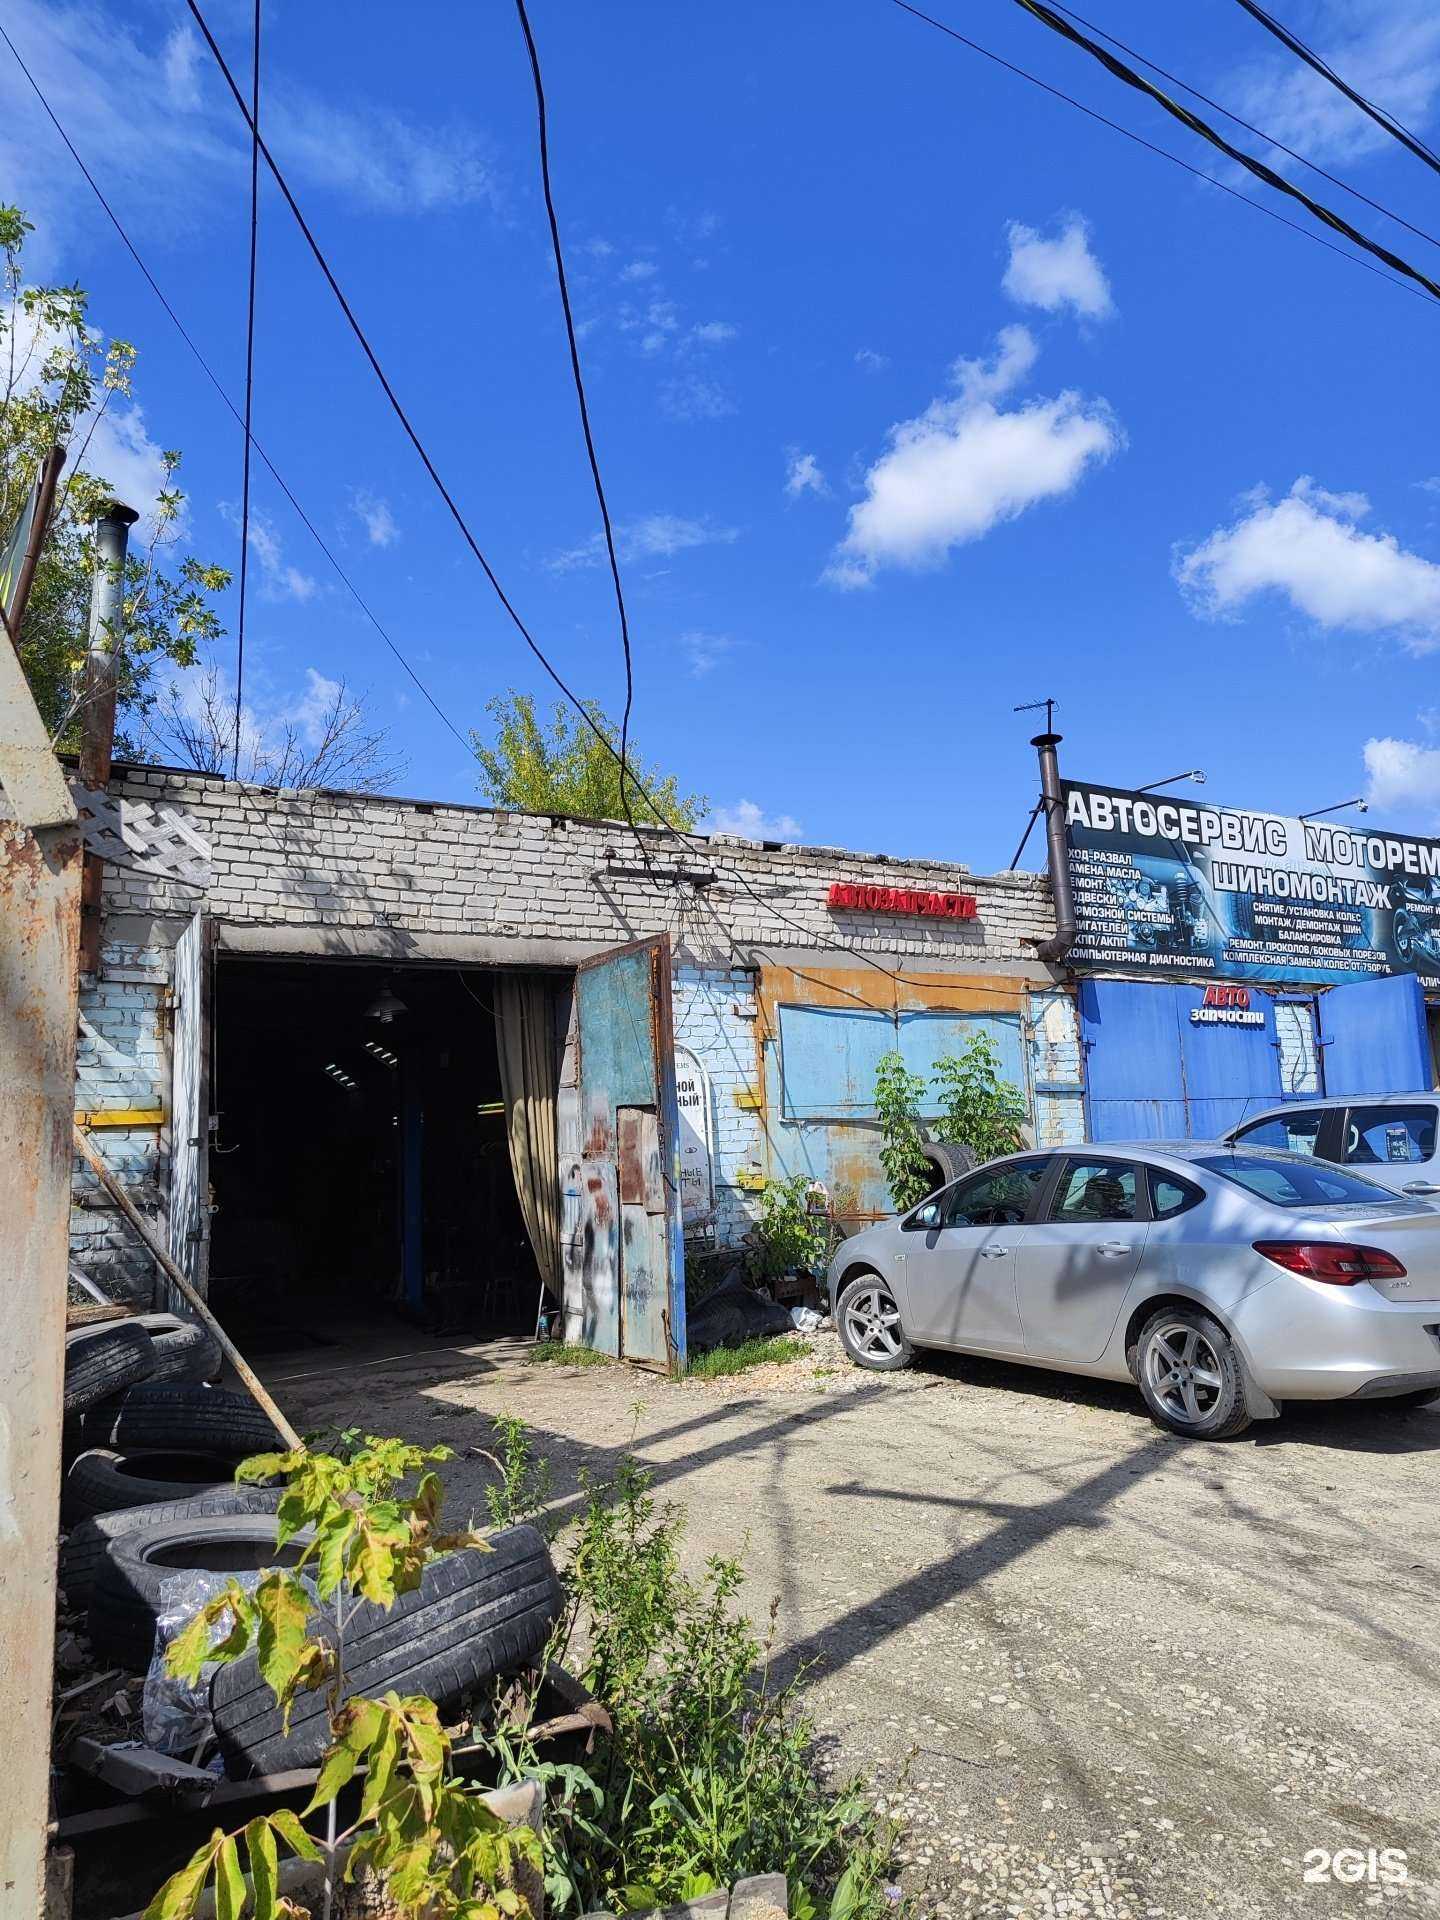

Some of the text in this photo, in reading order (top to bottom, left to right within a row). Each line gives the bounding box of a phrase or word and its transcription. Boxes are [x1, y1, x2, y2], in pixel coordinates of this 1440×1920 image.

[1065, 790, 1440, 876] АВТОСЕРВИС МОТОРЕМ
[1067, 848, 1132, 865] ХОД-РАЗВАЛ
[1069, 862, 1142, 880] АМЕНА МАСЛА
[1070, 876, 1106, 890] ЕМОНТ:
[1212, 861, 1392, 909] ШИНОМОНТАЖ
[828, 883, 977, 918] АВТОЗАПЧАСТИ
[1072, 891, 1117, 905] ДВЕСКИ
[1074, 905, 1175, 924] РМОЗНОЙ СИСТЕМЫ
[1253, 901, 1362, 923] СНЯТИЕ/УСТАНОВКА КОЛЕС
[1405, 902, 1435, 914] РЕМОНТ
[1075, 919, 1128, 934] ИГАТЕЛЕЙ
[1254, 914, 1362, 934] МОНТАЖ/ДЕМОНТАЖ ШИН
[1075, 933, 1128, 948] КПП/АКПП
[1278, 930, 1342, 945] БАЛАНСИРОВКА
[1065, 947, 1216, 968] КОМПЬЮТЕРНАЯ ДИАГНОСТИКА
[1229, 938, 1387, 961] РЕМОНТ ПРОКОЛОВ/БОКОВЫХ ПОРЕЗОВ
[1223, 951, 1287, 966] КОМПЛЕКСНАЯ
[1288, 956, 1322, 969] ЗАМЕНА
[1323, 960, 1350, 971] КОЛЕС
[1351, 962, 1362, 971] ОТ
[1203, 986, 1250, 1007] АВТО
[1190, 1008, 1265, 1024] запчасти
